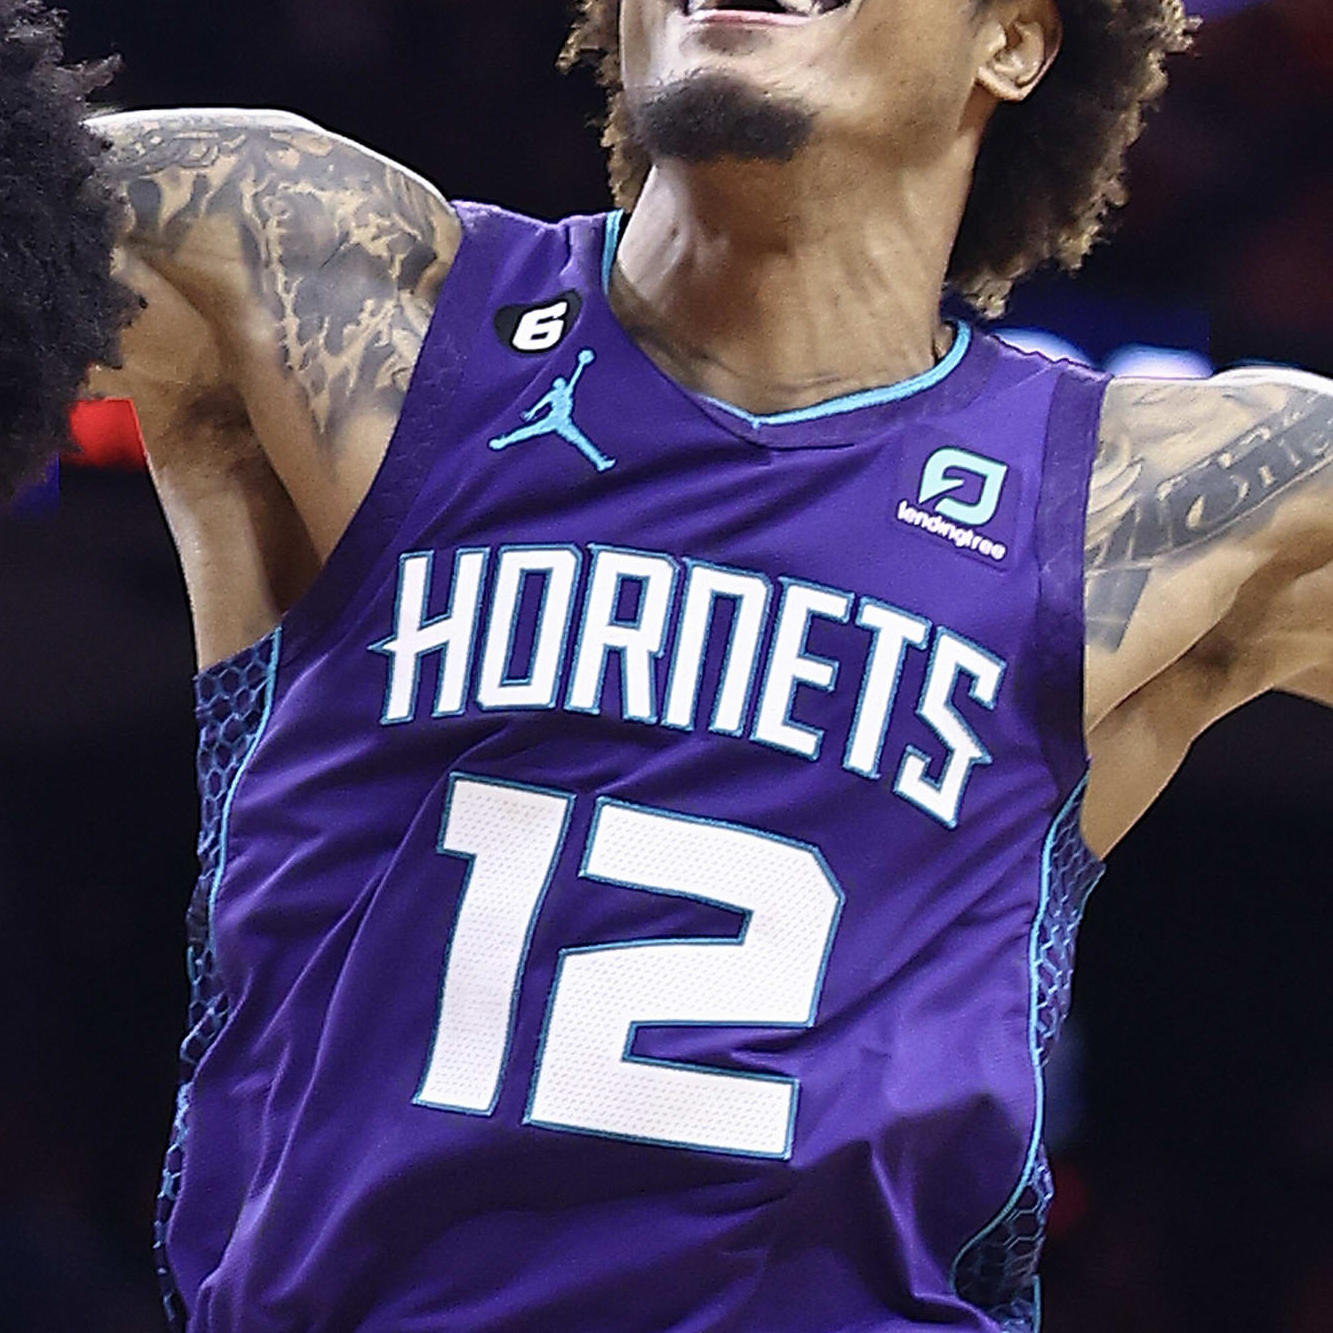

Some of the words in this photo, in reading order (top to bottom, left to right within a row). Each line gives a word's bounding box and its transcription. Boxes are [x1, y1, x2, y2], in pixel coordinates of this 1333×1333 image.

[510, 300, 568, 351] 6
[897, 499, 1007, 561] lendingtree
[369, 543, 1008, 830] HORNETS
[412, 771, 845, 1160] 12
